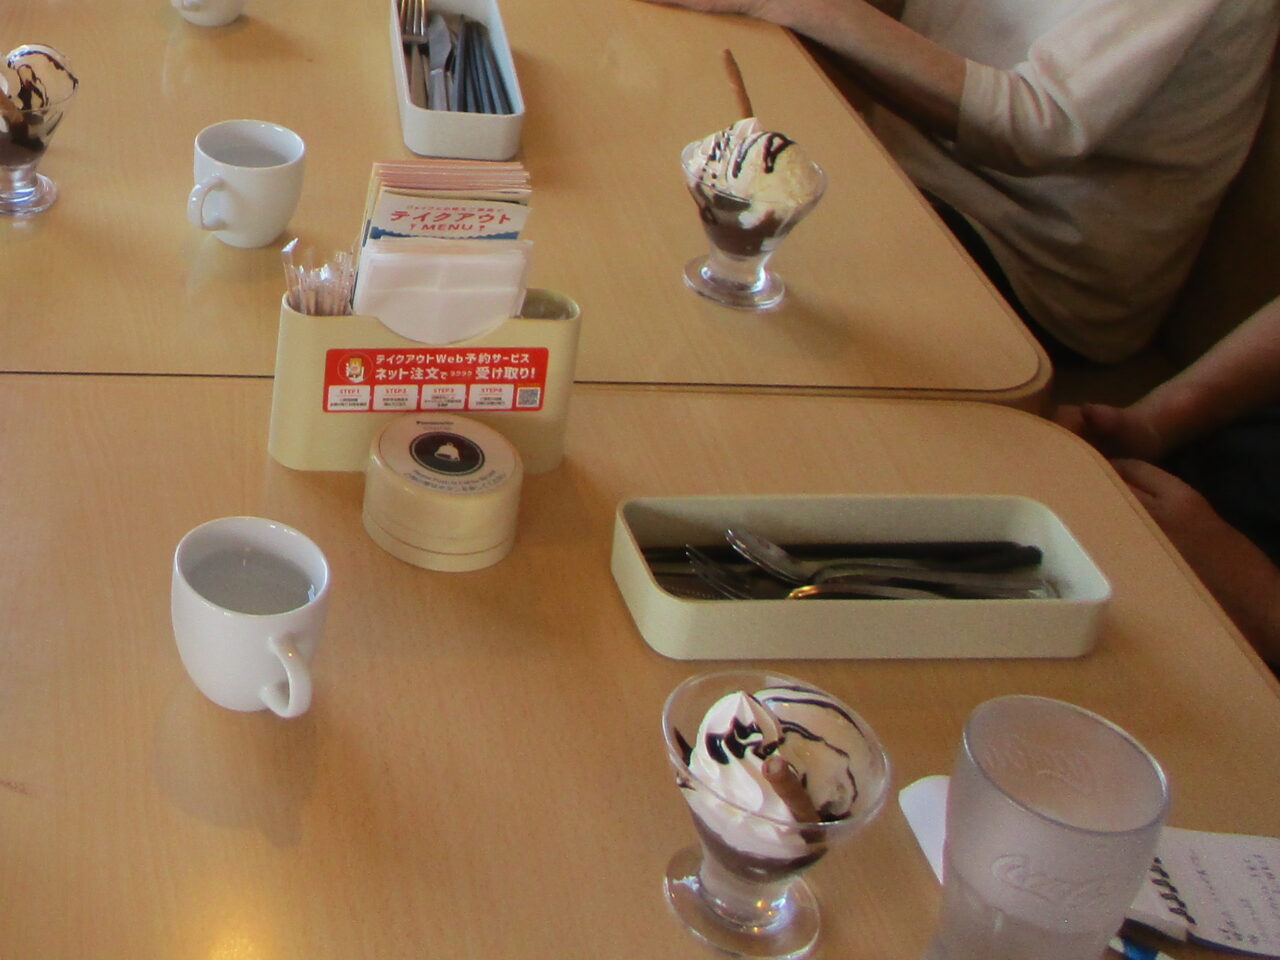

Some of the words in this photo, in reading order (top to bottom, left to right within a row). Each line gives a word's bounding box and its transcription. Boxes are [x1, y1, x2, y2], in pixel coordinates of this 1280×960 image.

[390, 210, 512, 226] テイクアウト
[421, 223, 473, 232] MENU
[375, 352, 530, 365] テイクアウトWeb予約サービス
[475, 365, 537, 381] 受け取り!
